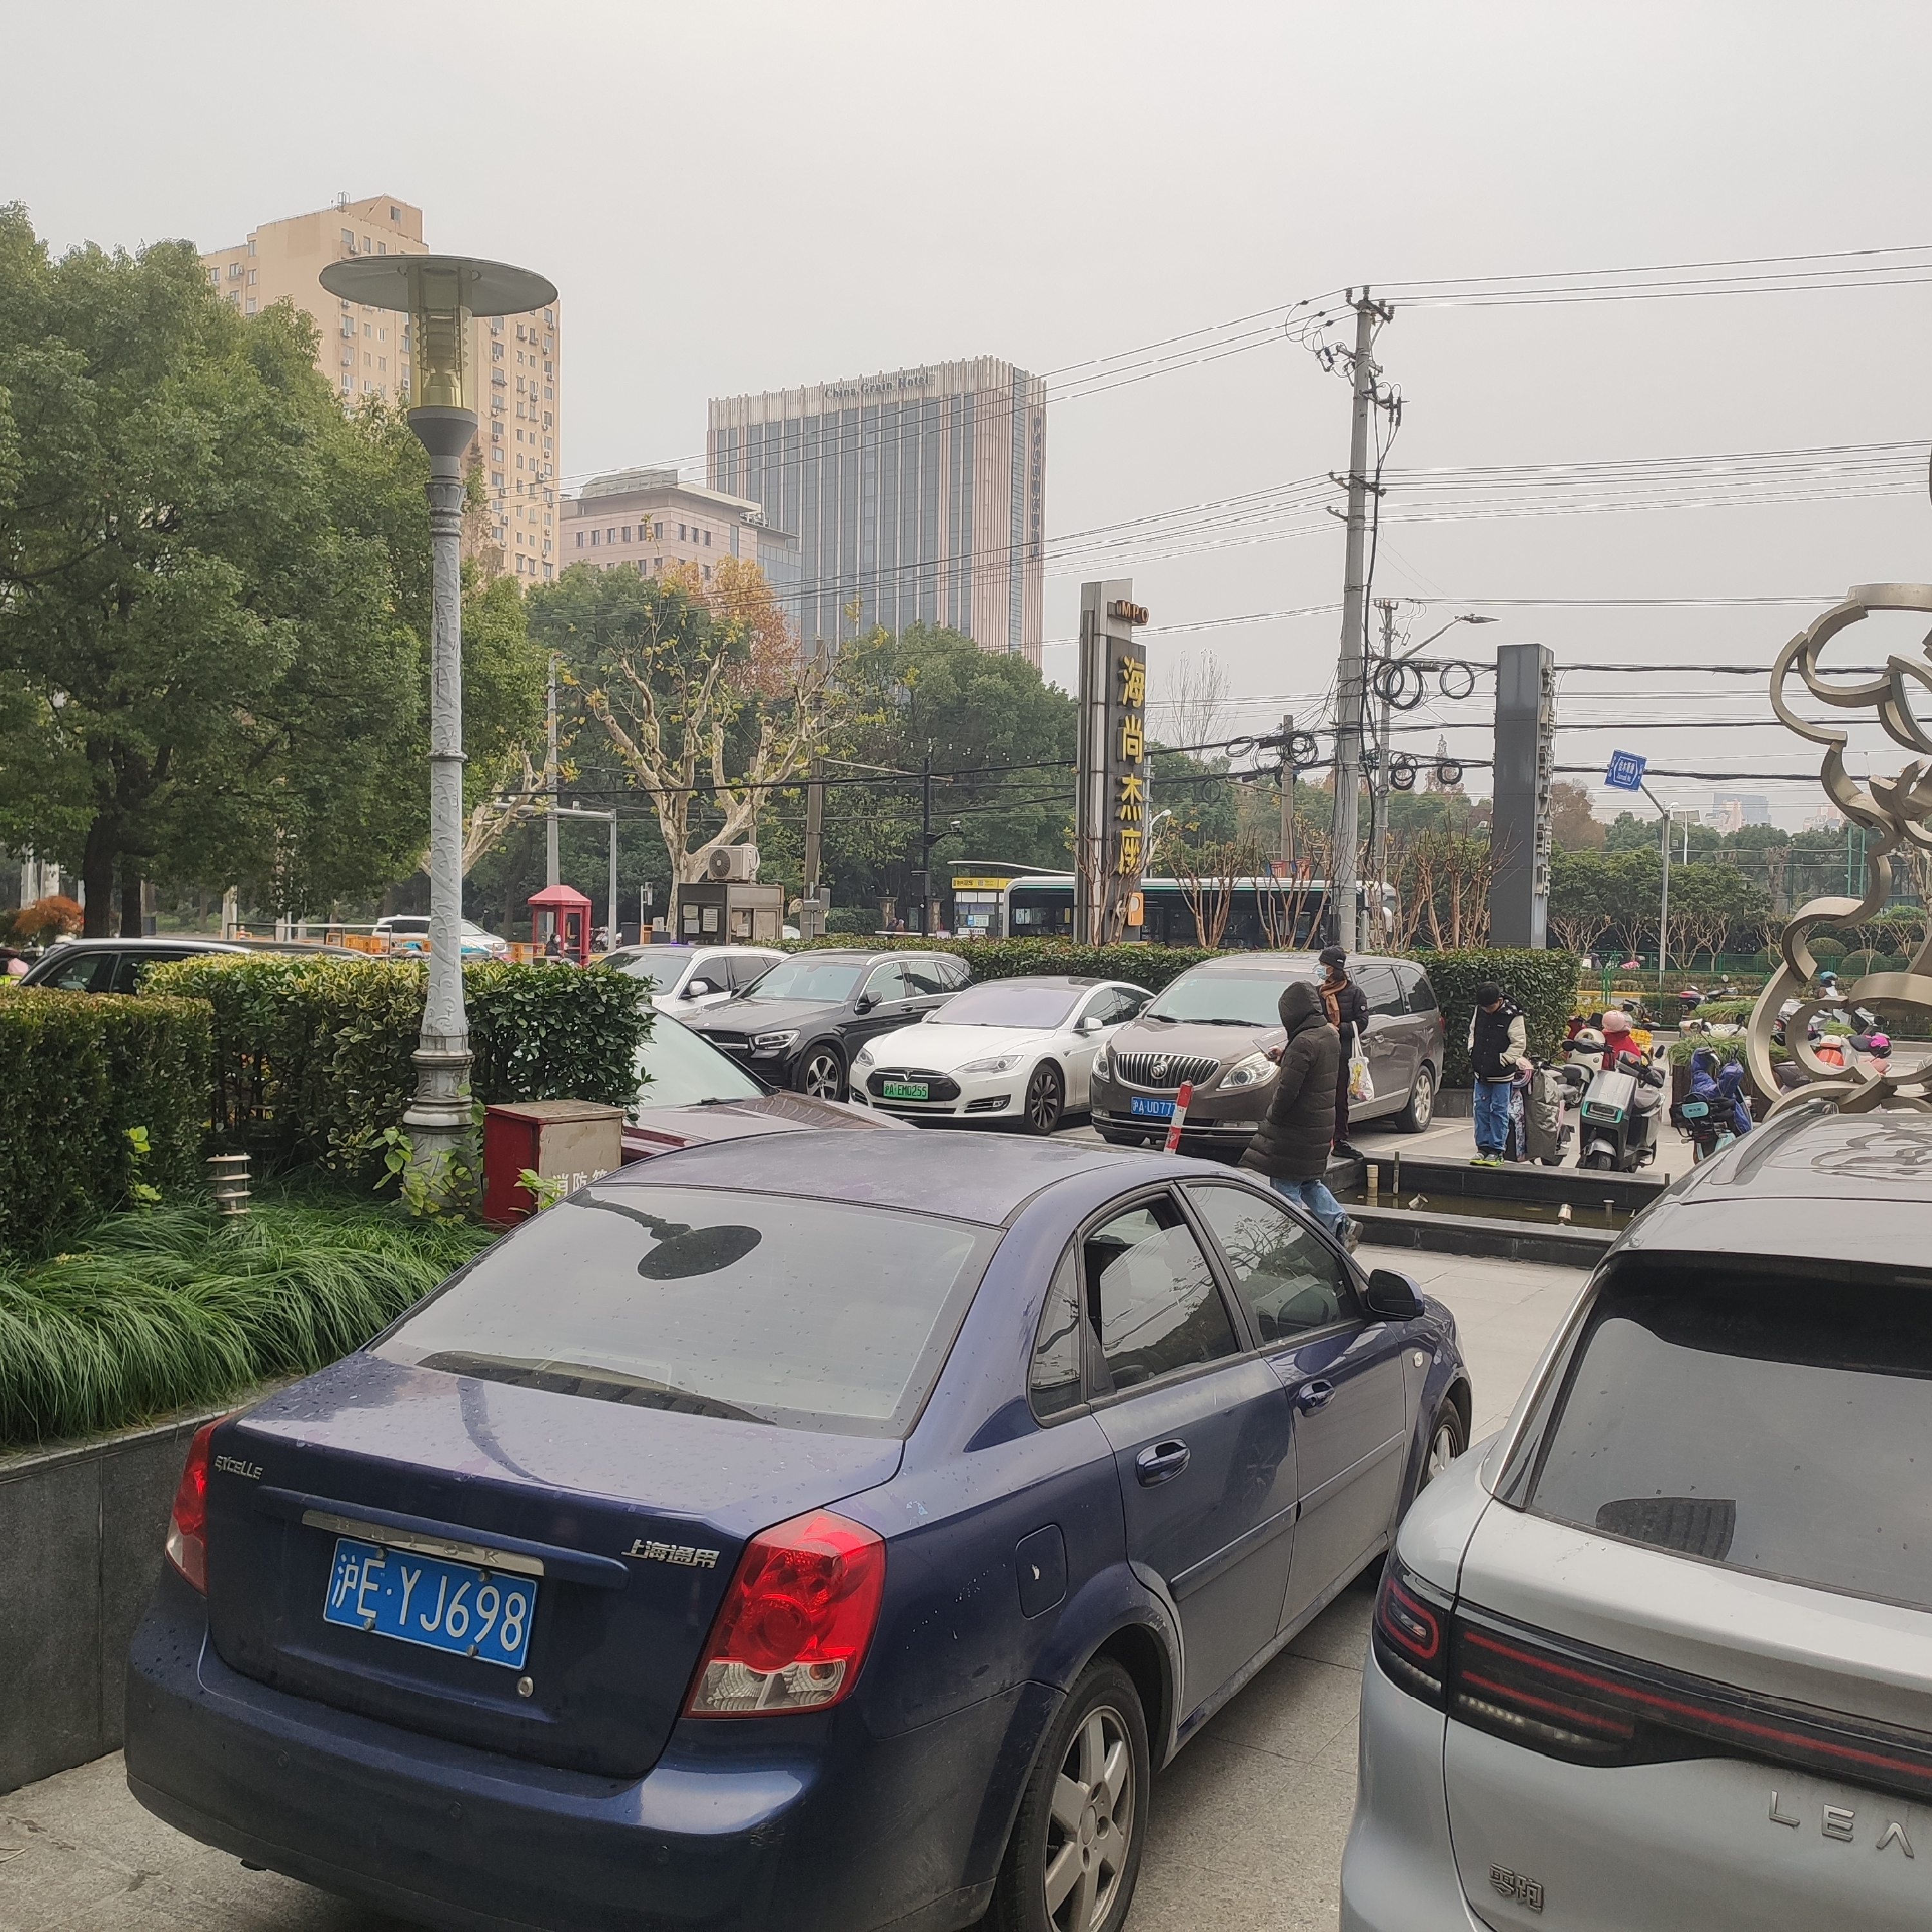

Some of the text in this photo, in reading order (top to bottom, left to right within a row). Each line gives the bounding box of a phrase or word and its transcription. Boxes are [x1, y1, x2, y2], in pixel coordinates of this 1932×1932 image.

[824, 372, 929, 398] China Grain Hotel
[1119, 654, 1145, 875] 海尚杰座
[620, 1539, 721, 1569] 上海通用
[1488, 1862, 1544, 1915] 零跑
